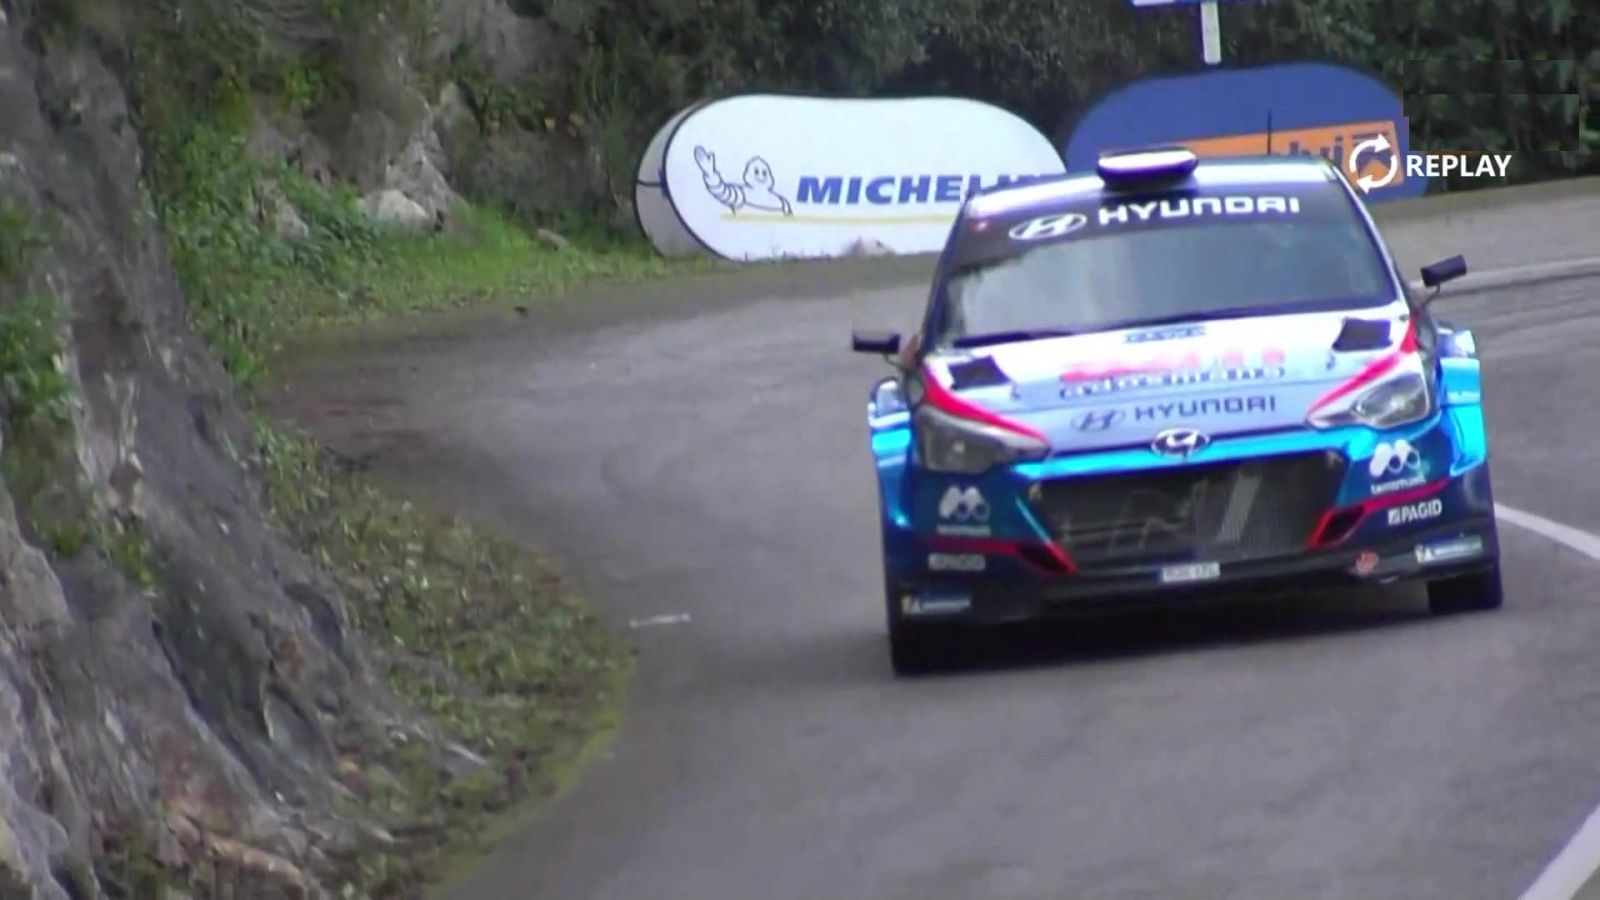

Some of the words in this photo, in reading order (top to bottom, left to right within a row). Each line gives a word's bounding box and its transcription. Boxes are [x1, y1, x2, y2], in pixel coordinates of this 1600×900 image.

[1099, 196, 1300, 226] HYUNDAI
[1135, 395, 1276, 431] HYUNDAI
[1401, 499, 1443, 523] PAGID
